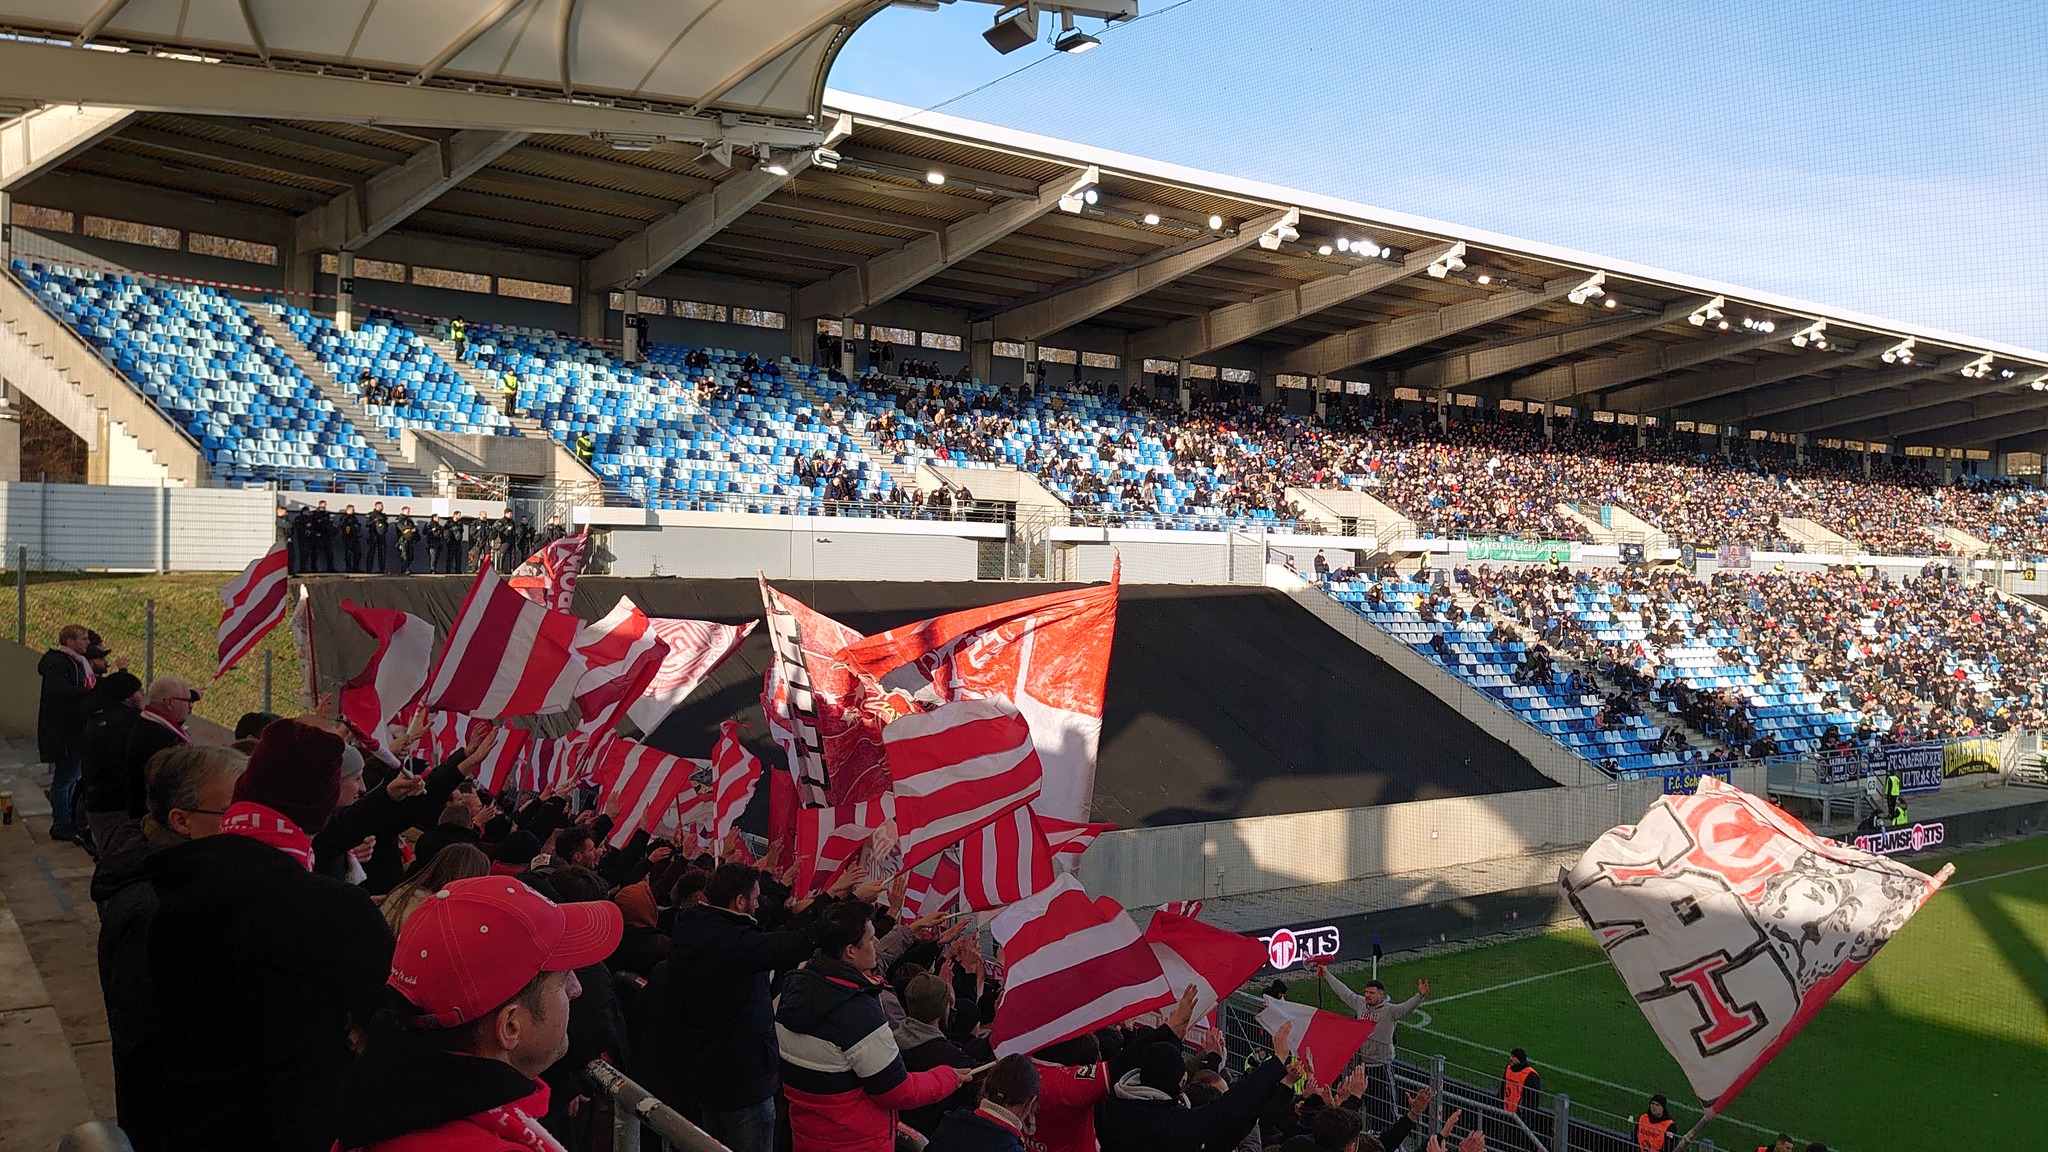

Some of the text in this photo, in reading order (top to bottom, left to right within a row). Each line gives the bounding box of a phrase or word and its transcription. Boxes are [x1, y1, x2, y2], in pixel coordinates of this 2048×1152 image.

[343, 281, 353, 290] T2
[628, 317, 637, 325] T3
[1516, 542, 1537, 552] GEGEN
[1944, 739, 1981, 776] VERLEBTE
[1902, 769, 1930, 787] ULTRAS
[1867, 780, 1876, 791] G3
